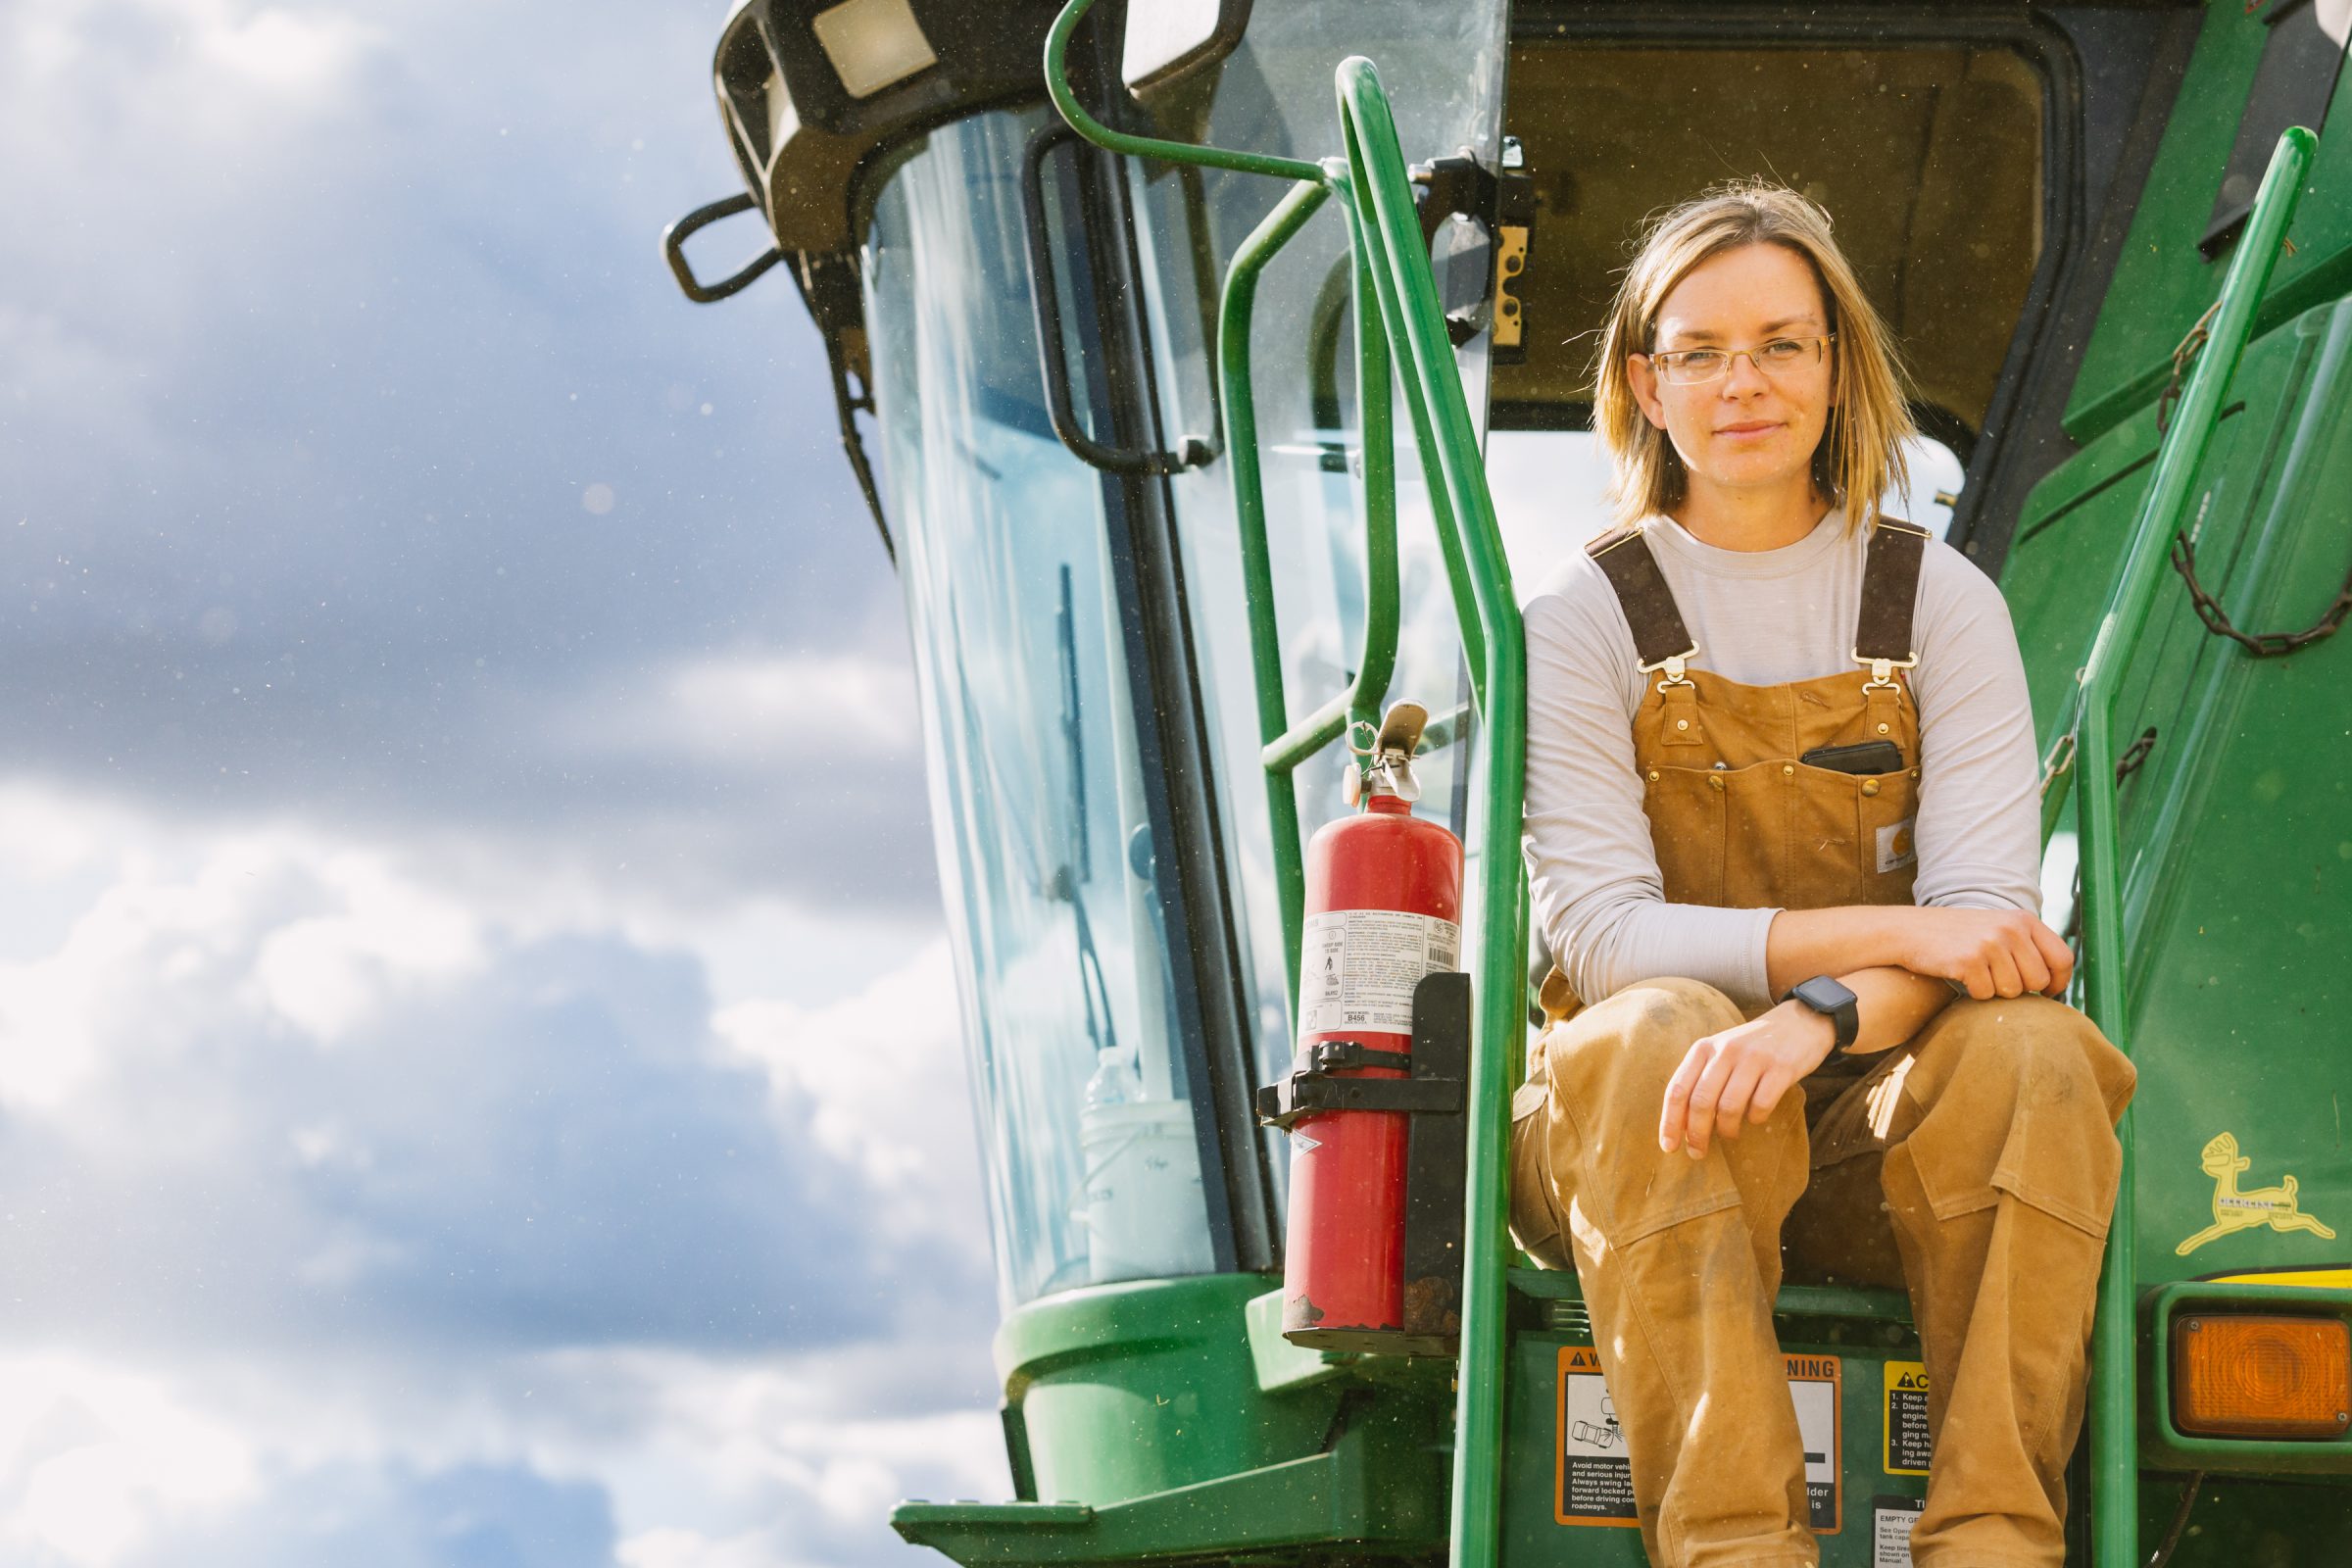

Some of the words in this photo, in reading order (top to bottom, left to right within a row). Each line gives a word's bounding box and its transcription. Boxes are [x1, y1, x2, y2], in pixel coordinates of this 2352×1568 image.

[1787, 1359, 1835, 1378] NING
[1902, 1394, 1923, 1402] Keep
[1902, 1440, 1923, 1448] Keep
[1902, 1449, 1915, 1458] ing
[1572, 1478, 1598, 1487] Always
[1811, 1499, 1822, 1509] is
